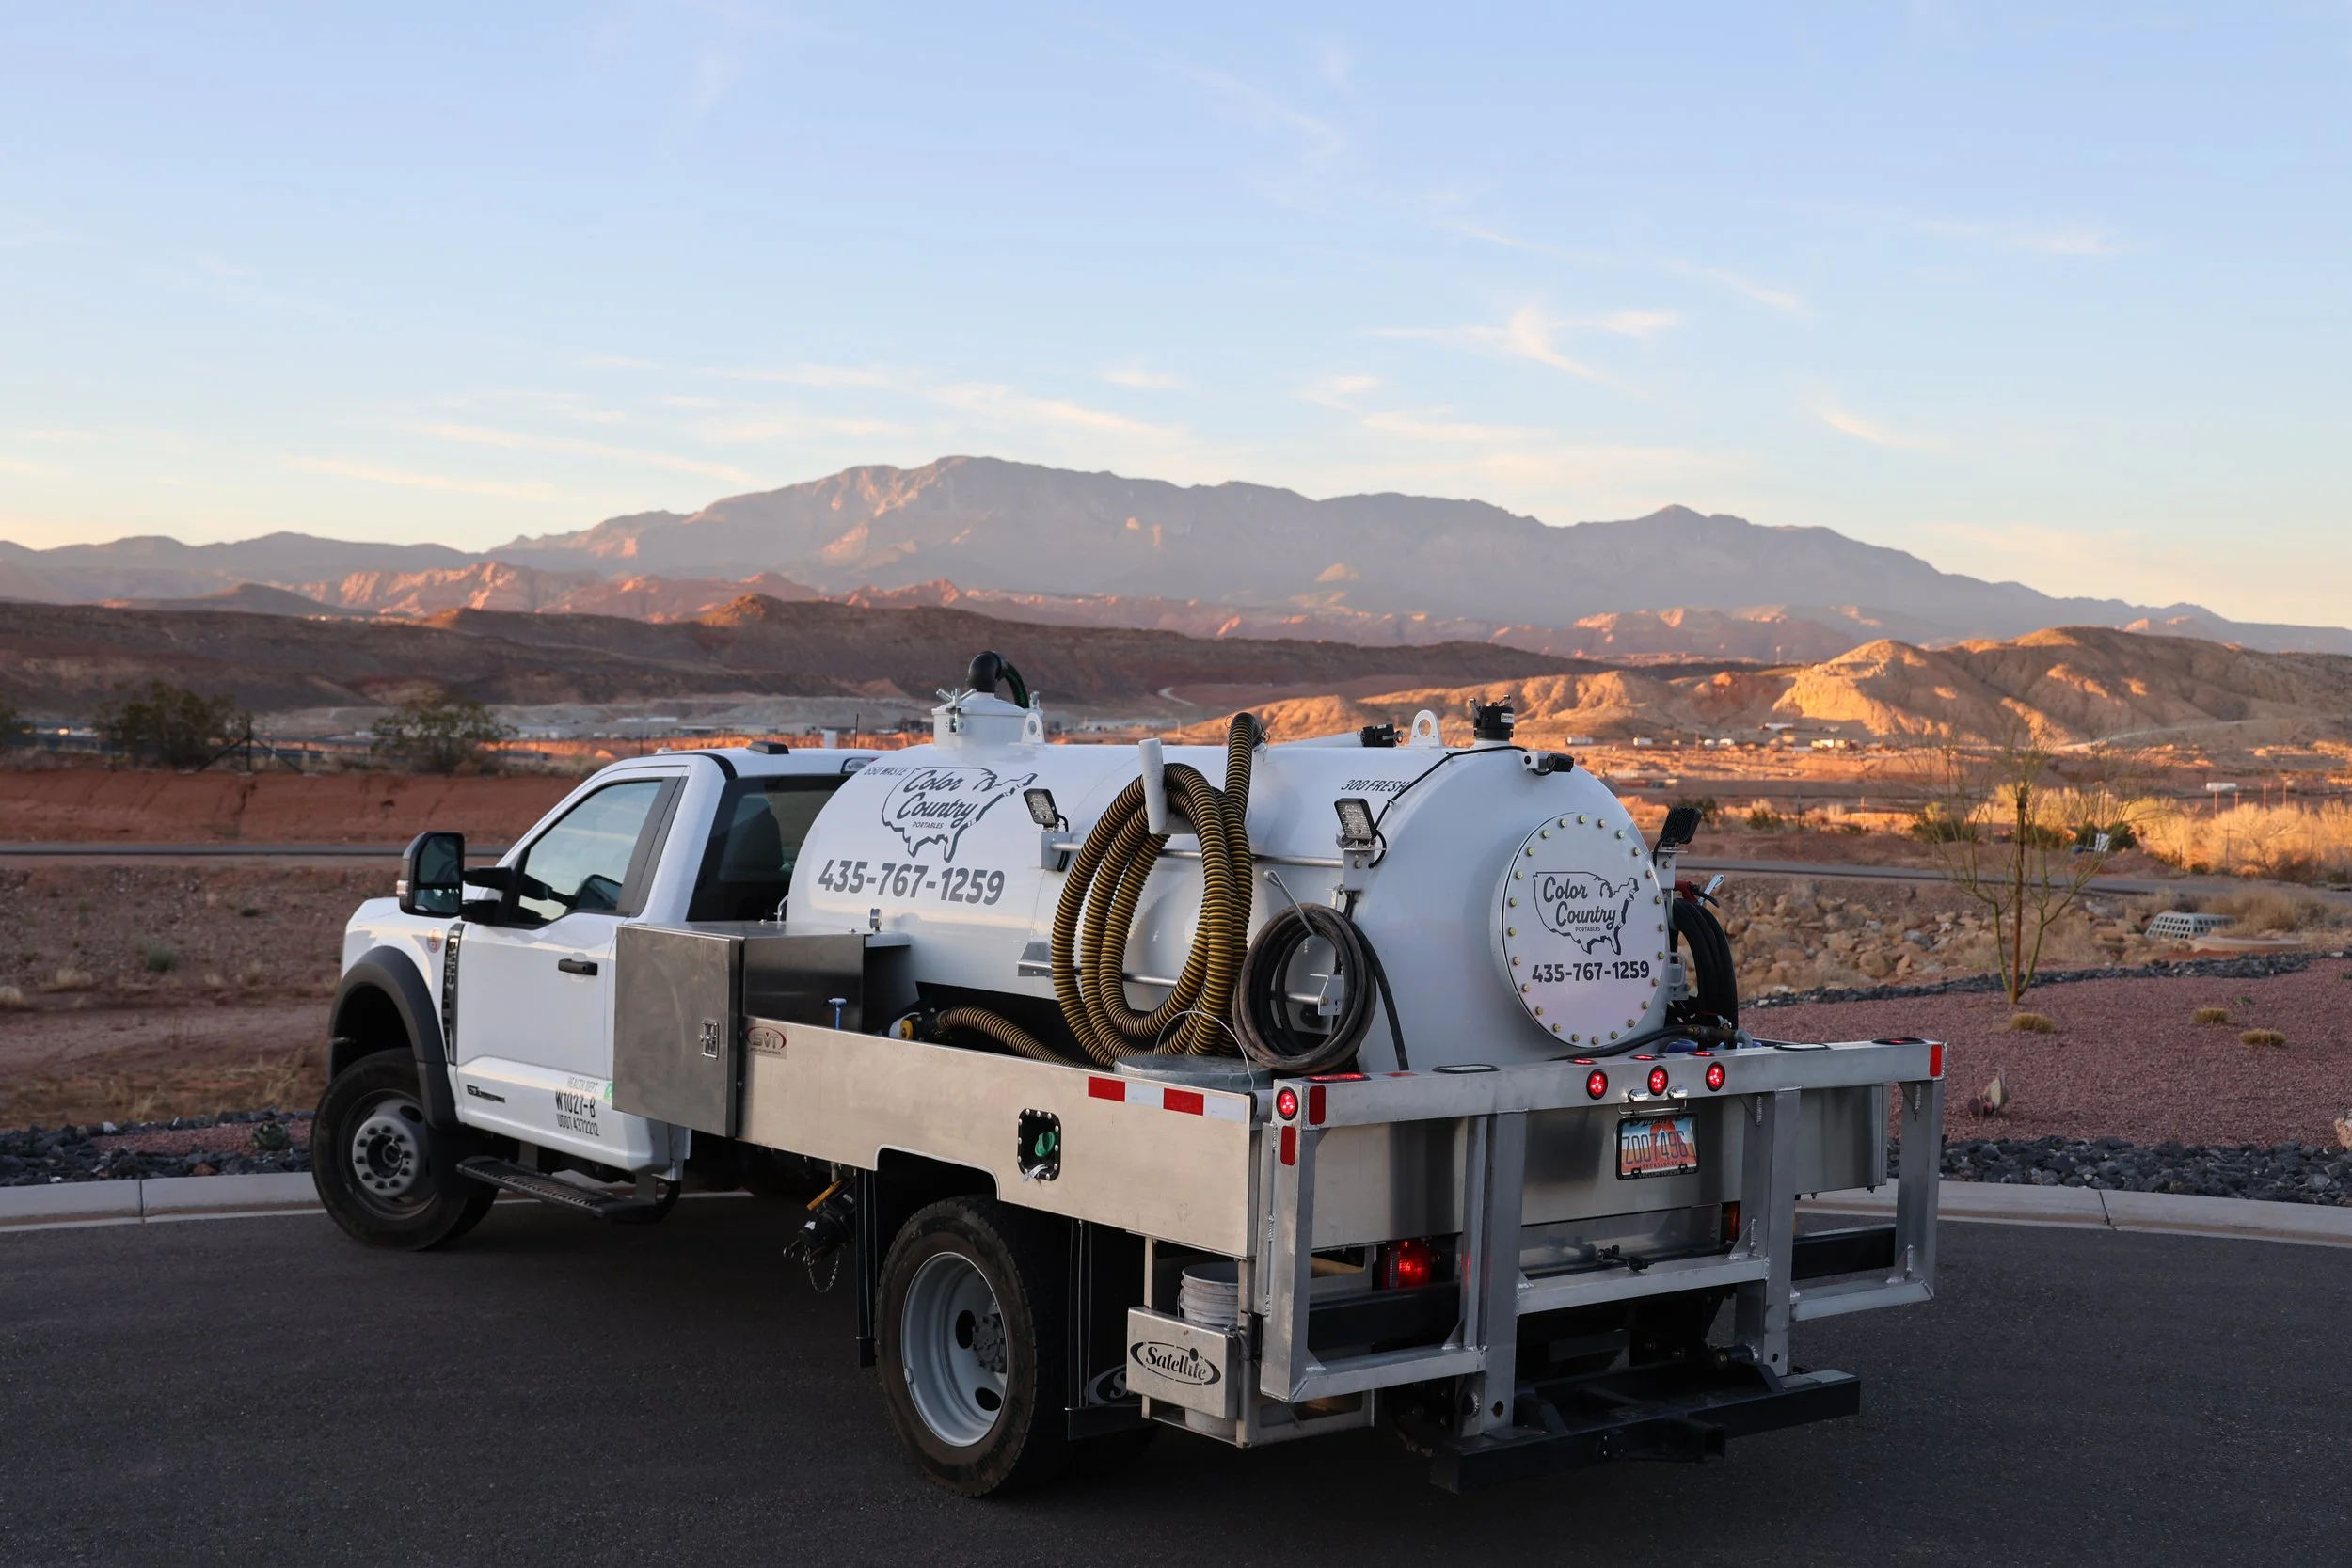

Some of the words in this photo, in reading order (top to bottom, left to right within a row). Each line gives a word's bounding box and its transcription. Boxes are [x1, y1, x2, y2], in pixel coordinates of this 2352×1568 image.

[880, 767, 912, 776] WASTE
[903, 769, 964, 793] Color
[1341, 779, 1370, 791] 300
[1364, 780, 1411, 792] FRESH
[896, 791, 979, 829] Country
[912, 820, 945, 830] PORTABLES
[818, 859, 1006, 906] 435-767-1259
[1543, 876, 1588, 903] Color
[1555, 900, 1617, 930] Country
[1532, 960, 1650, 983] 435-767-1259
[1146, 1346, 1207, 1381] Satellite
